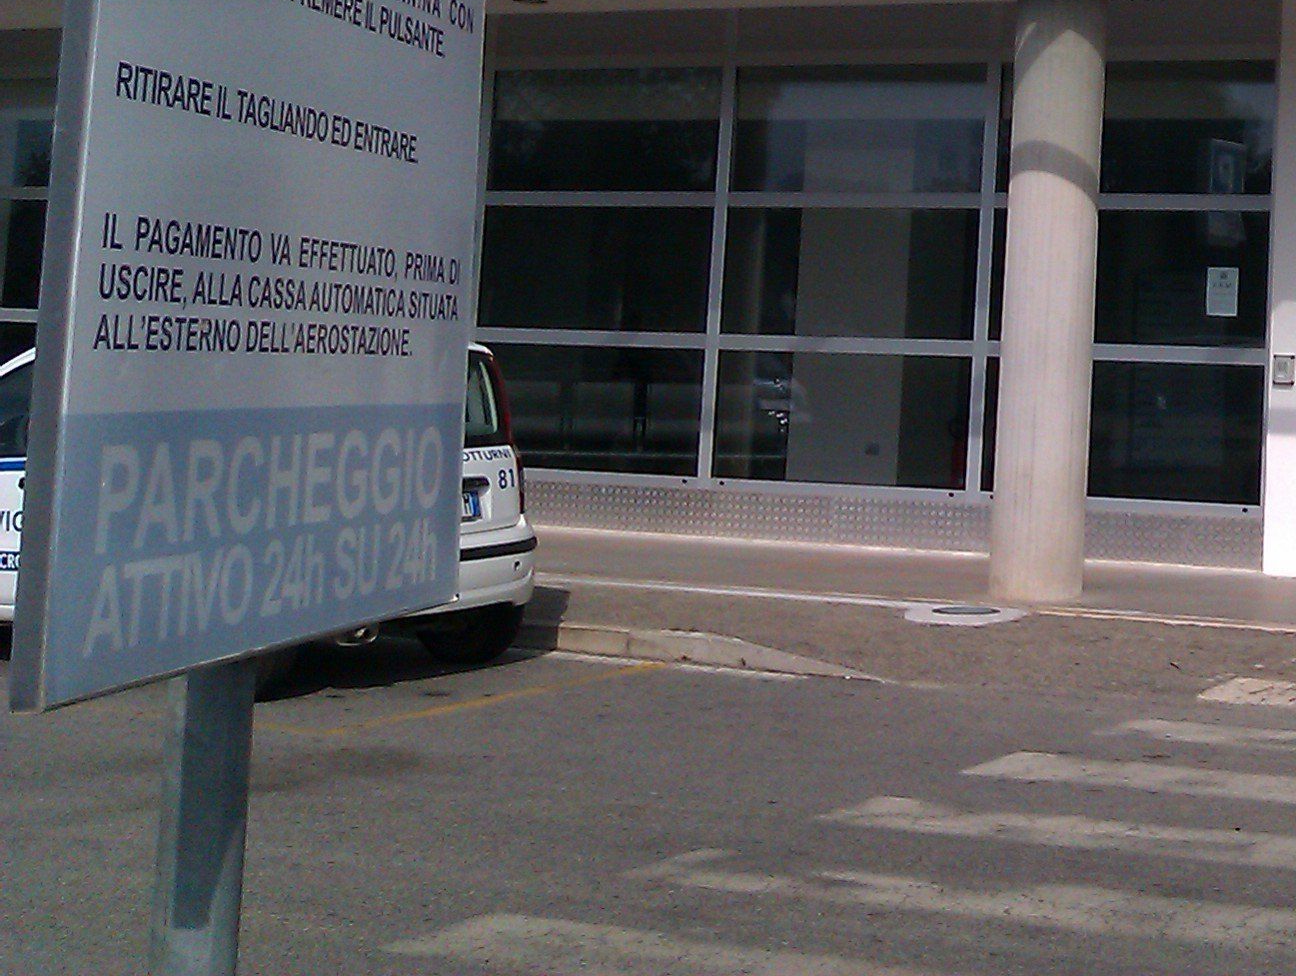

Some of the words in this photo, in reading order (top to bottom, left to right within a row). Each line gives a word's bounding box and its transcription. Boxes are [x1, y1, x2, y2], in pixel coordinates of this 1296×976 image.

[365, 1, 376, 32] IL
[116, 61, 213, 116] RITIRARE
[216, 85, 231, 120] IL
[237, 89, 328, 142] TAGLIANDO
[331, 115, 351, 147] ED
[102, 212, 123, 250] IL
[135, 216, 262, 263] PAGAMENTO
[271, 233, 291, 265] VA
[299, 237, 398, 281] EFFETTUATO,
[405, 252, 444, 283] PRIMA
[449, 258, 461, 284] DI
[100, 263, 187, 310] USCIRE,
[192, 271, 243, 306] ALLA
[249, 275, 307, 310] CASSA
[309, 281, 405, 318] AUTOMATICA
[408, 291, 458, 320] SITUATA
[93, 314, 241, 352] ALL'ESTERNO
[245, 321, 412, 356] DELL'AEROSTAZIONE.
[95, 427, 443, 554] PARCHEGGIO
[499, 469, 514, 489] 81
[82, 543, 252, 657] ATTIVO
[259, 532, 324, 616] 24h
[335, 522, 382, 599] SU
[385, 517, 437, 590] 24h
